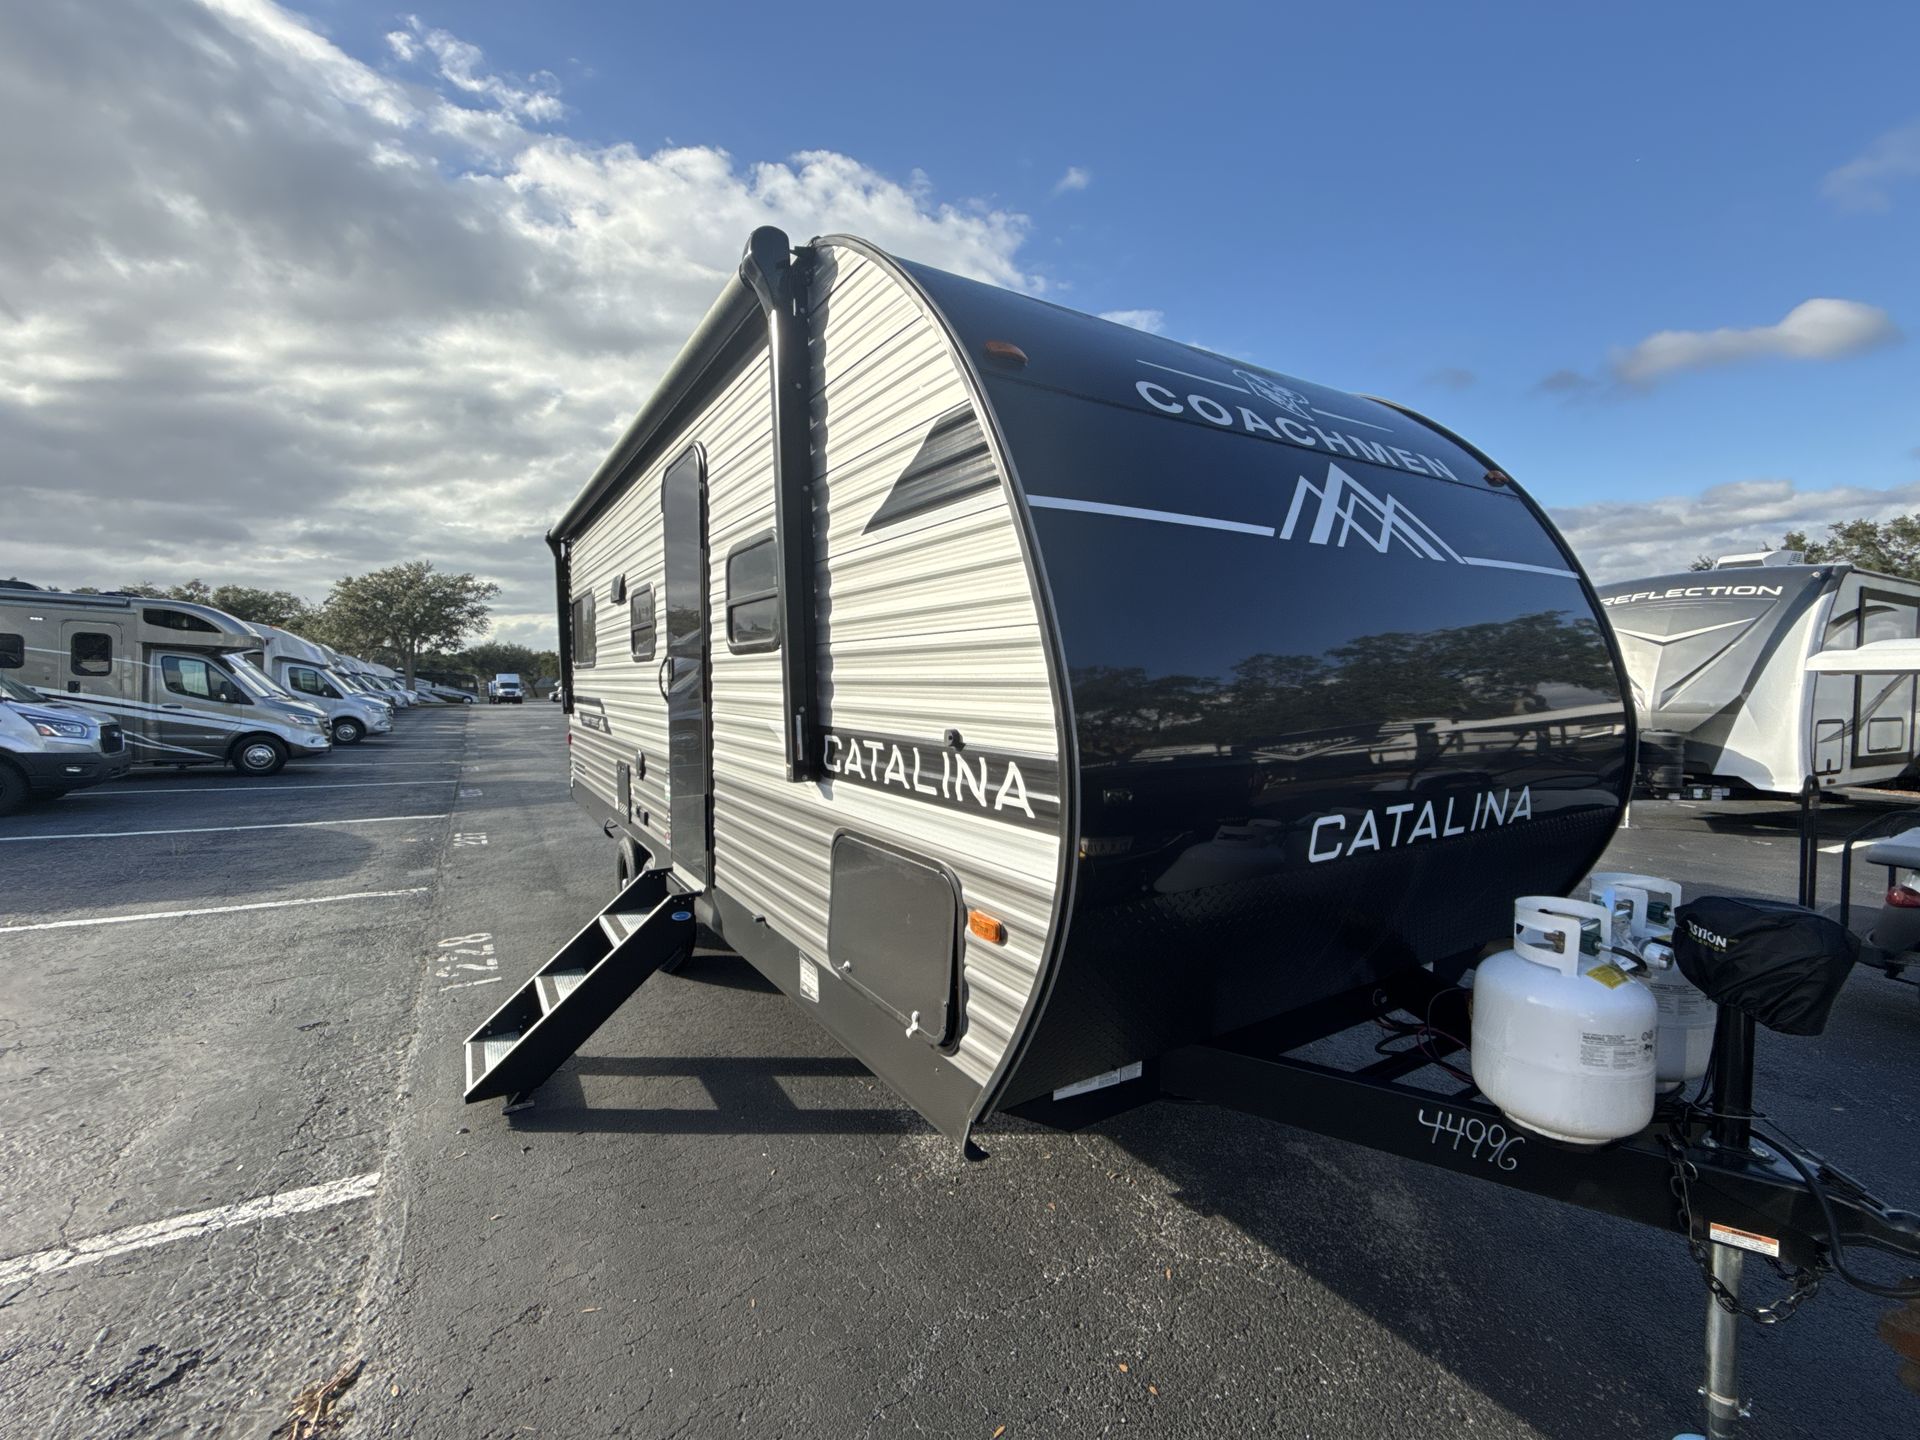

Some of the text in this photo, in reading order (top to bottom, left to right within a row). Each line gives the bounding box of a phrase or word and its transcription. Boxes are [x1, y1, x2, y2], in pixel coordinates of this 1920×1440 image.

[1135, 380, 1460, 481] COACHMEN
[1600, 585, 1783, 606] REFLECTION
[823, 734, 1036, 819] CATALINA
[1308, 785, 1532, 863] CATALINA
[1418, 1109, 1526, 1171] 44996
